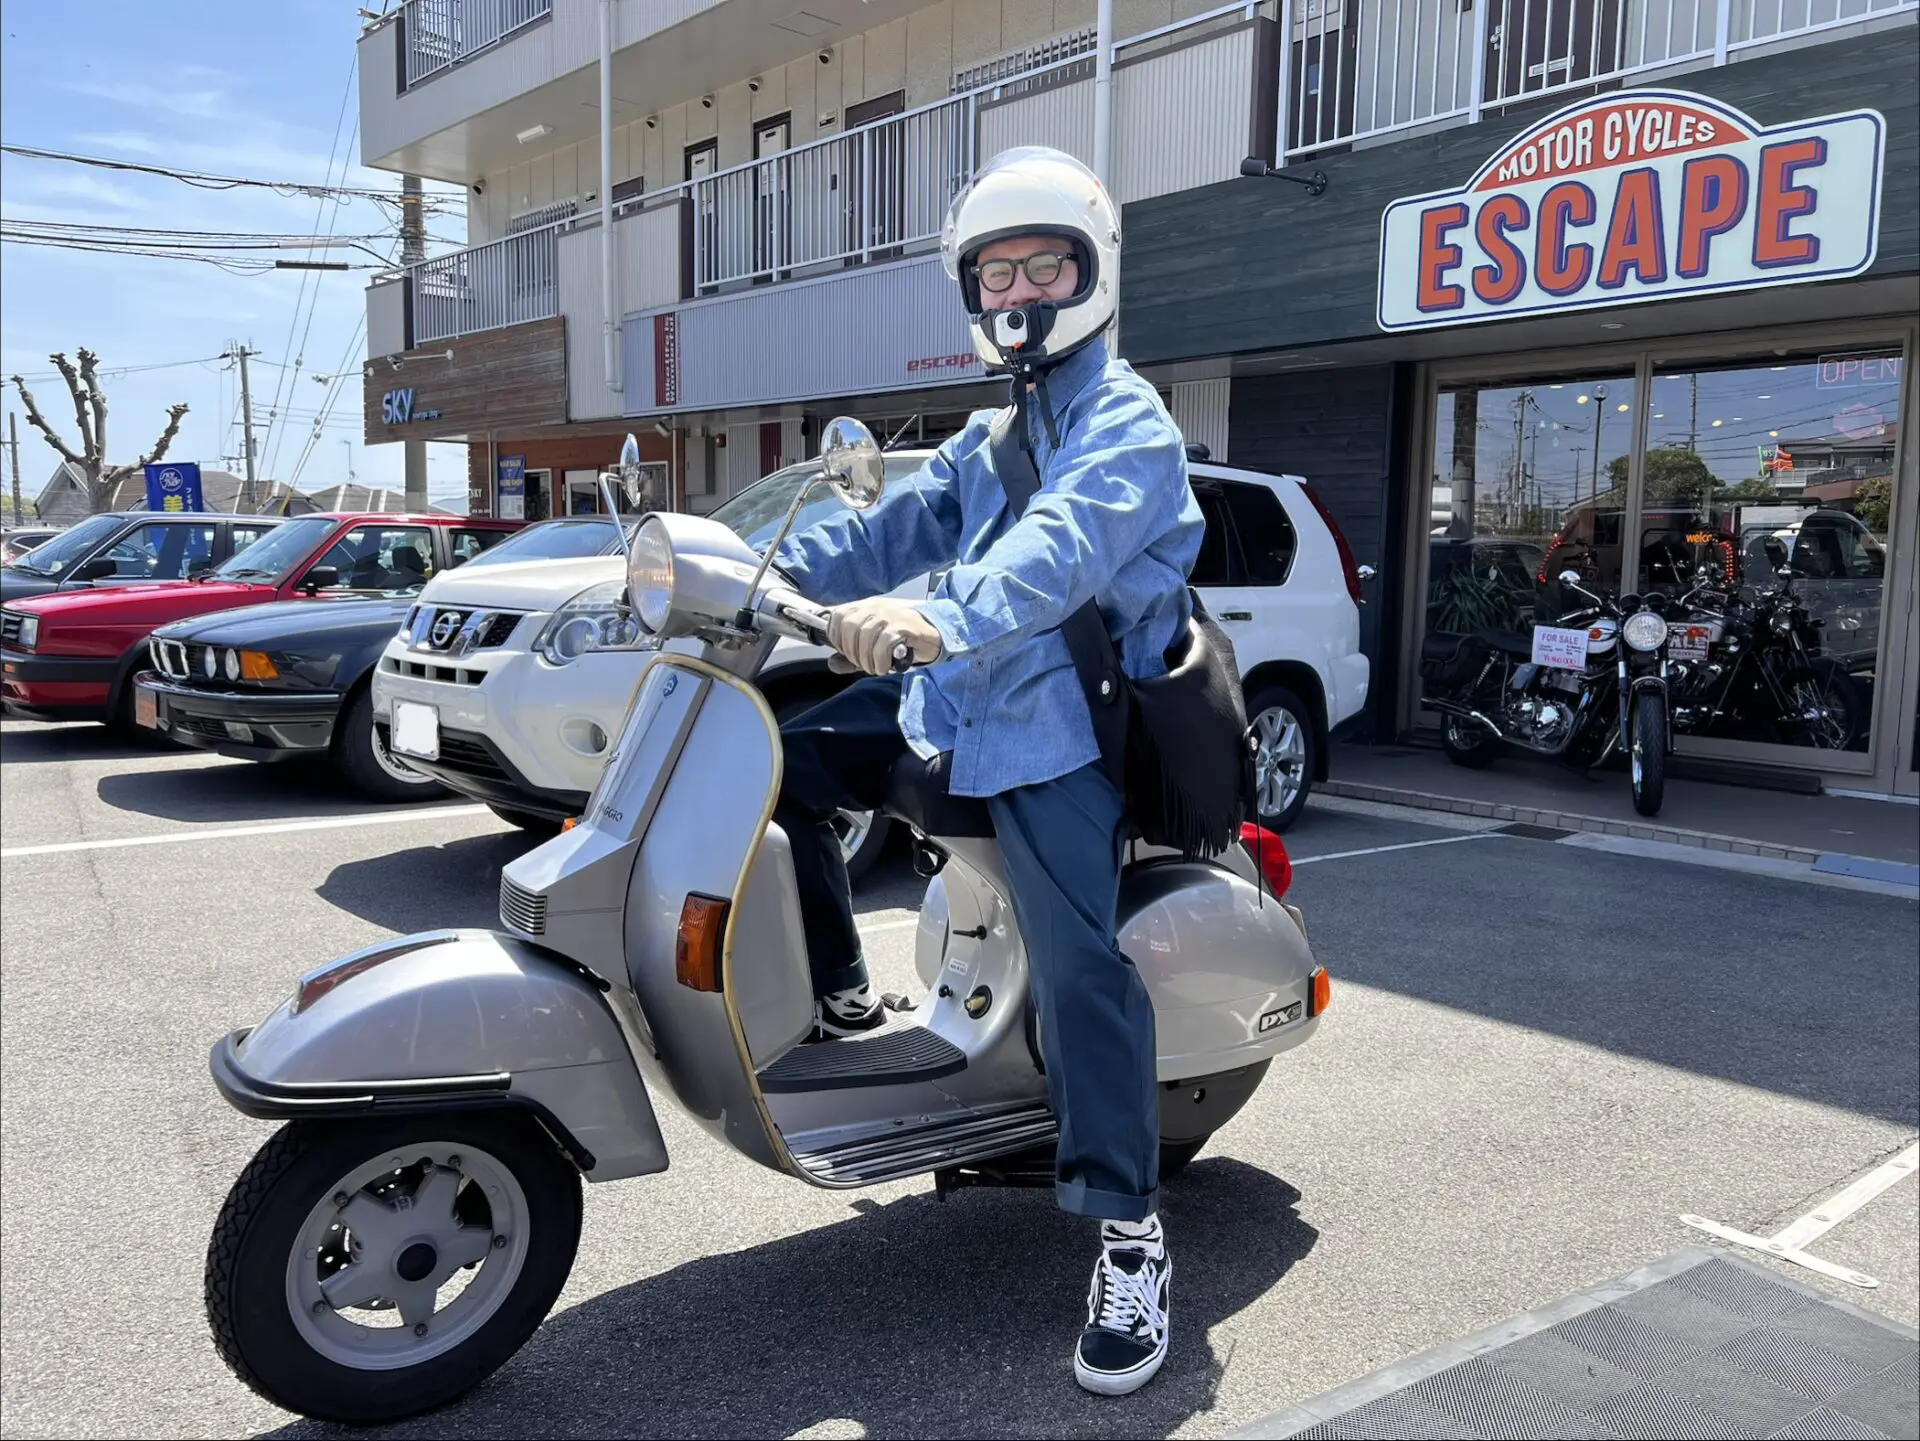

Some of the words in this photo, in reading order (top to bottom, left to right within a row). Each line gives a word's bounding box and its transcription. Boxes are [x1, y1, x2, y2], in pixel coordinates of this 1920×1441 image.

[1498, 117, 1594, 182] MOTOR
[1603, 108, 1717, 161] CYCLES
[1416, 136, 1828, 313] ESCAPE
[906, 352, 980, 372] escap
[1822, 354, 1898, 384] OPEN
[382, 387, 415, 425] SKY
[1541, 632, 1558, 642] FOR
[1558, 635, 1579, 645] SALE
[1669, 634, 1707, 649] ALE
[1261, 1008, 1292, 1031] PX
